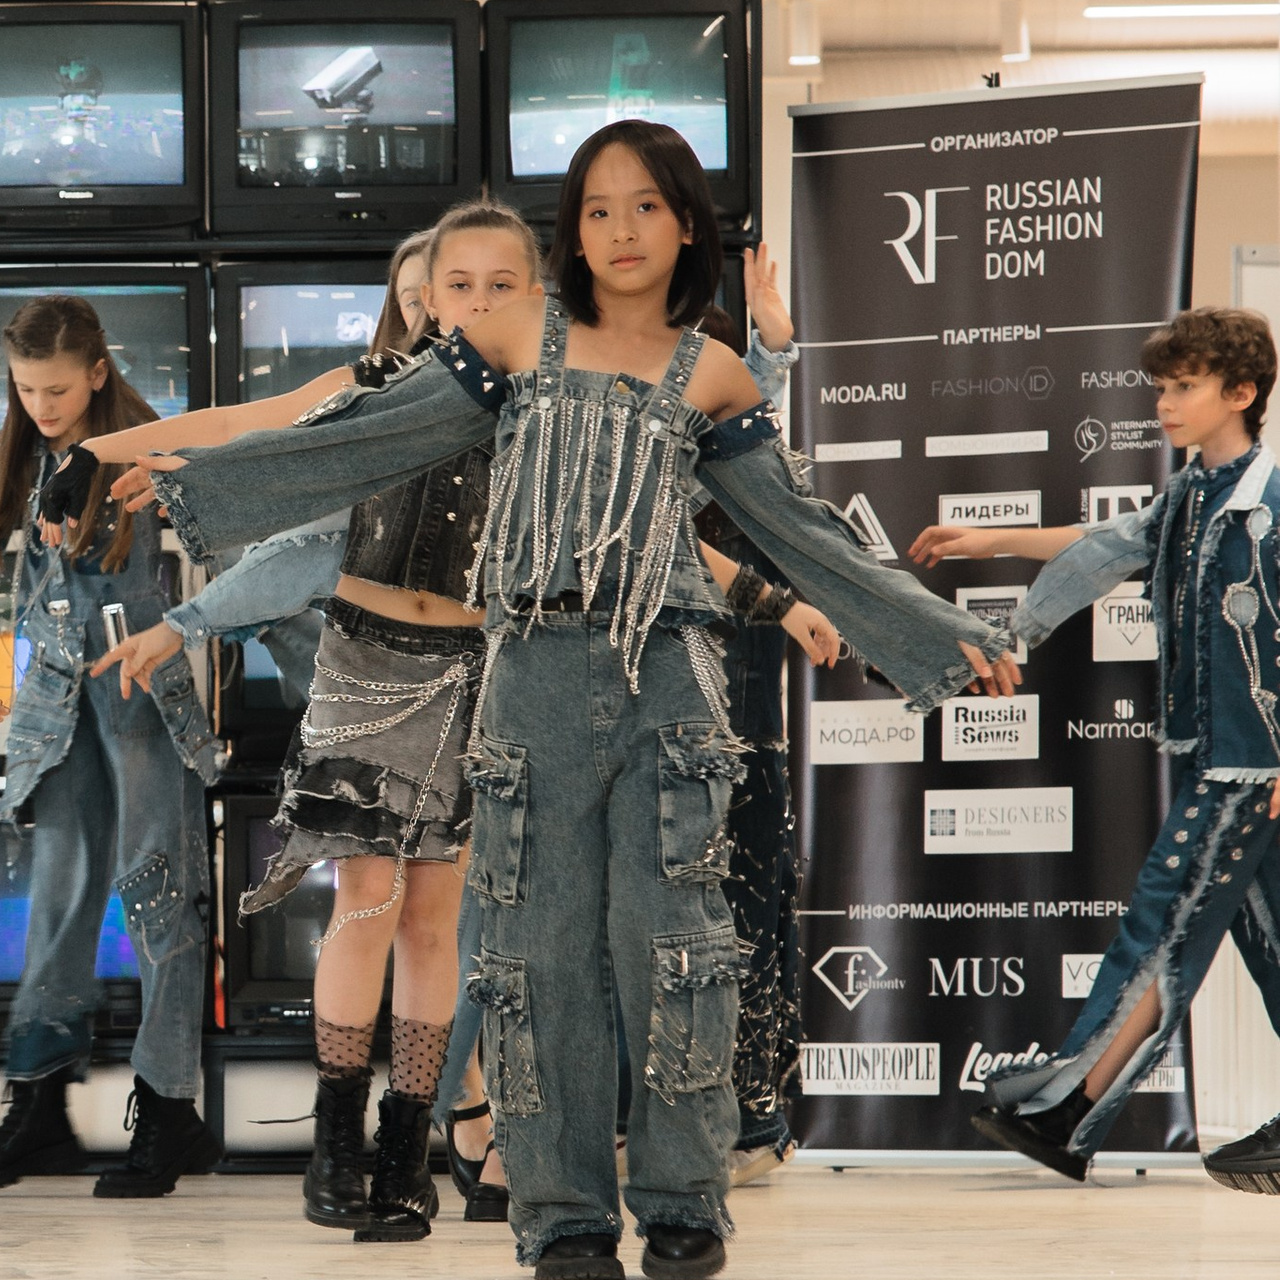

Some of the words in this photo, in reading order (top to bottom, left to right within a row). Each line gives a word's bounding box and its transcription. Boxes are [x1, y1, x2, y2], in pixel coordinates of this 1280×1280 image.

[930, 127, 1059, 152] ОРГАНИЗАТОР
[985, 176, 1102, 211] RUSSIAN
[985, 211, 1103, 246] FASHION
[985, 249, 1045, 280] DOM
[943, 324, 1041, 345] ПАРТНЕРЫ
[931, 377, 1019, 397] FASHION
[1081, 370, 1154, 389] FASHION.
[820, 382, 907, 405] MODA.RU
[1111, 420, 1161, 430] INTERNATIO
[1111, 430, 1143, 440] STYLIST
[1111, 440, 1163, 450] COMMUNITY
[950, 503, 1030, 520] ЛИДЕРЫ
[955, 705, 1027, 723] Russia
[820, 726, 916, 746] МОДА.РФ
[962, 727, 1019, 744] Sews
[964, 805, 1068, 825] DESIGNERS
[848, 902, 1028, 921] ИНФОРМАЦИОННЫЕ
[928, 957, 1025, 997] MUS
[803, 1047, 936, 1080] TRENDSPEOPLE
